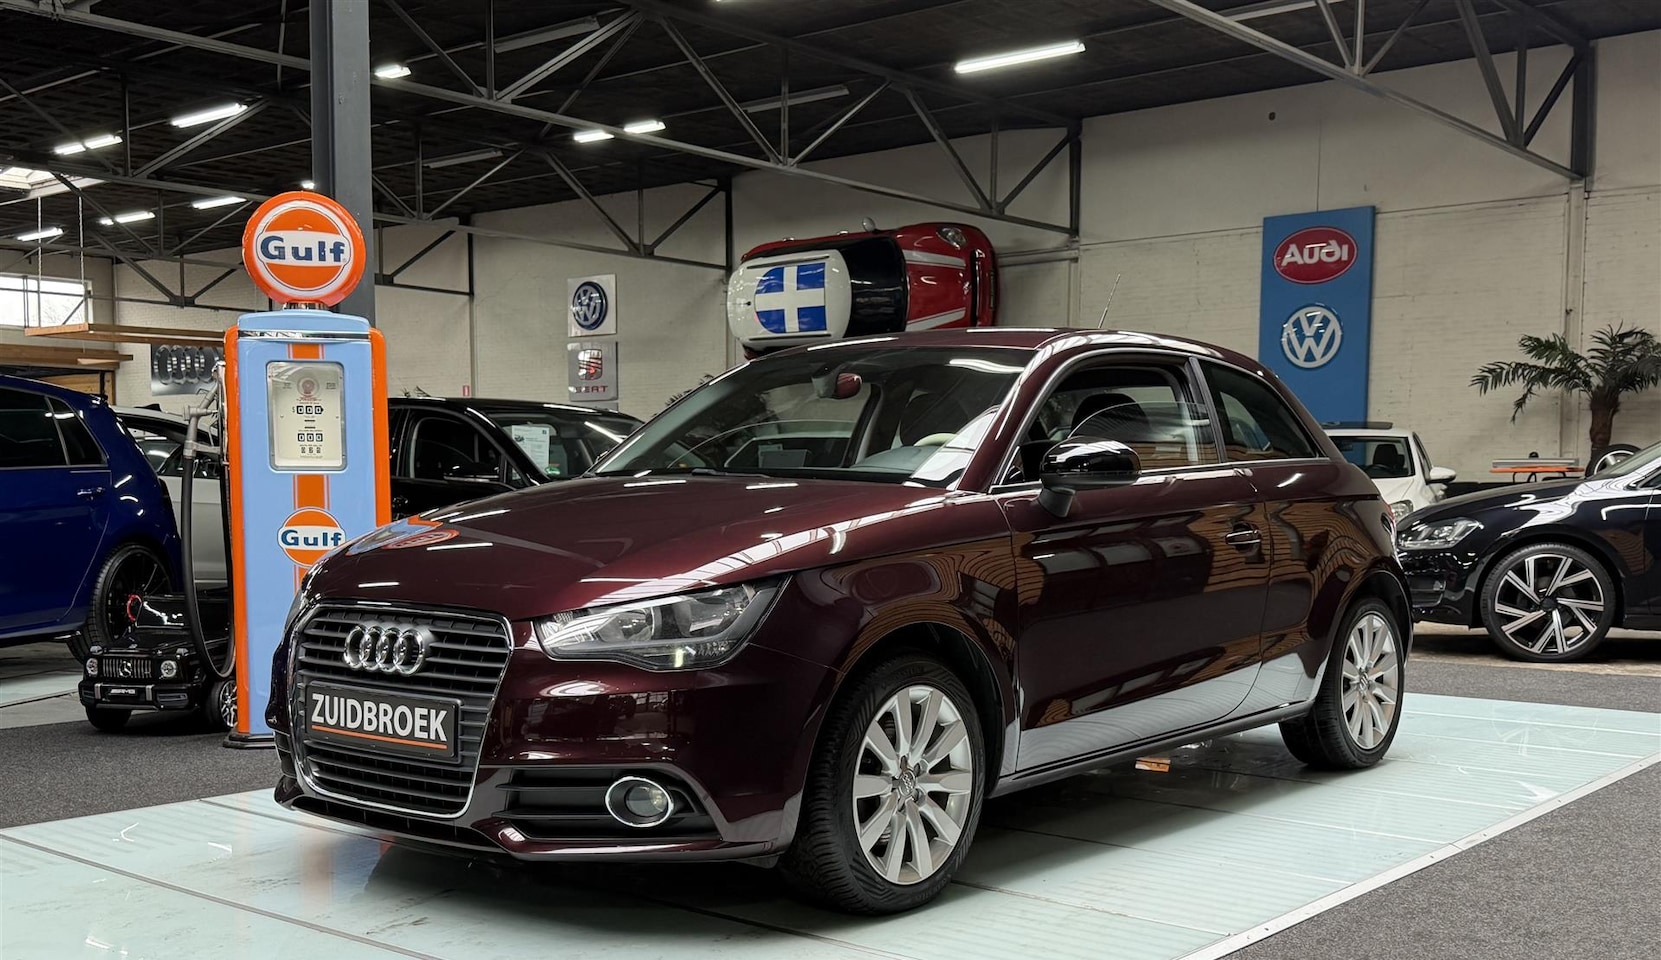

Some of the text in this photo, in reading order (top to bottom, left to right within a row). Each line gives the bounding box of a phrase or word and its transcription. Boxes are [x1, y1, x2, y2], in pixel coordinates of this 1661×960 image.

[260, 235, 345, 262] Gulf
[281, 529, 342, 547] Gulf
[311, 693, 447, 742] ZUIDBROEK
